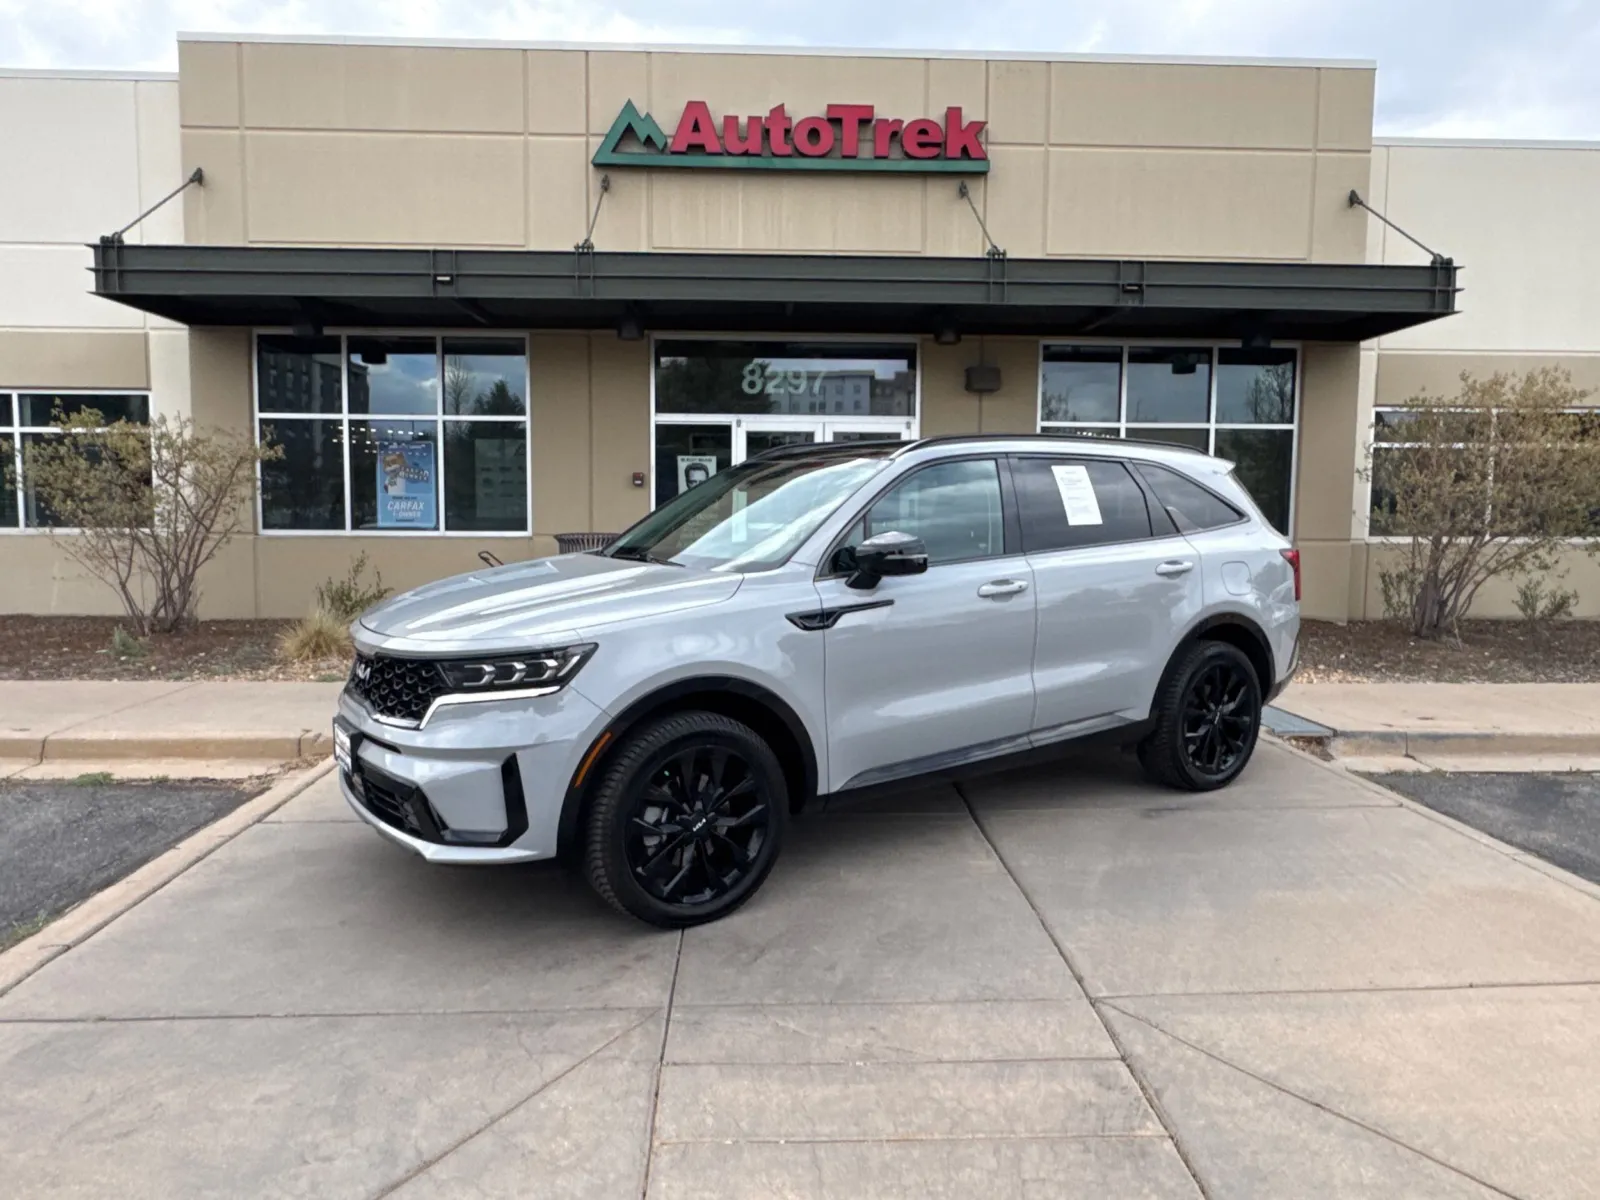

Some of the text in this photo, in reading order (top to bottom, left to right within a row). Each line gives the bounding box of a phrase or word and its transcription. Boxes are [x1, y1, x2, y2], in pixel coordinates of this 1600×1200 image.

[669, 100, 988, 160] AutoTrek
[741, 362, 828, 395] 8297
[387, 500, 425, 511] CARFAX
